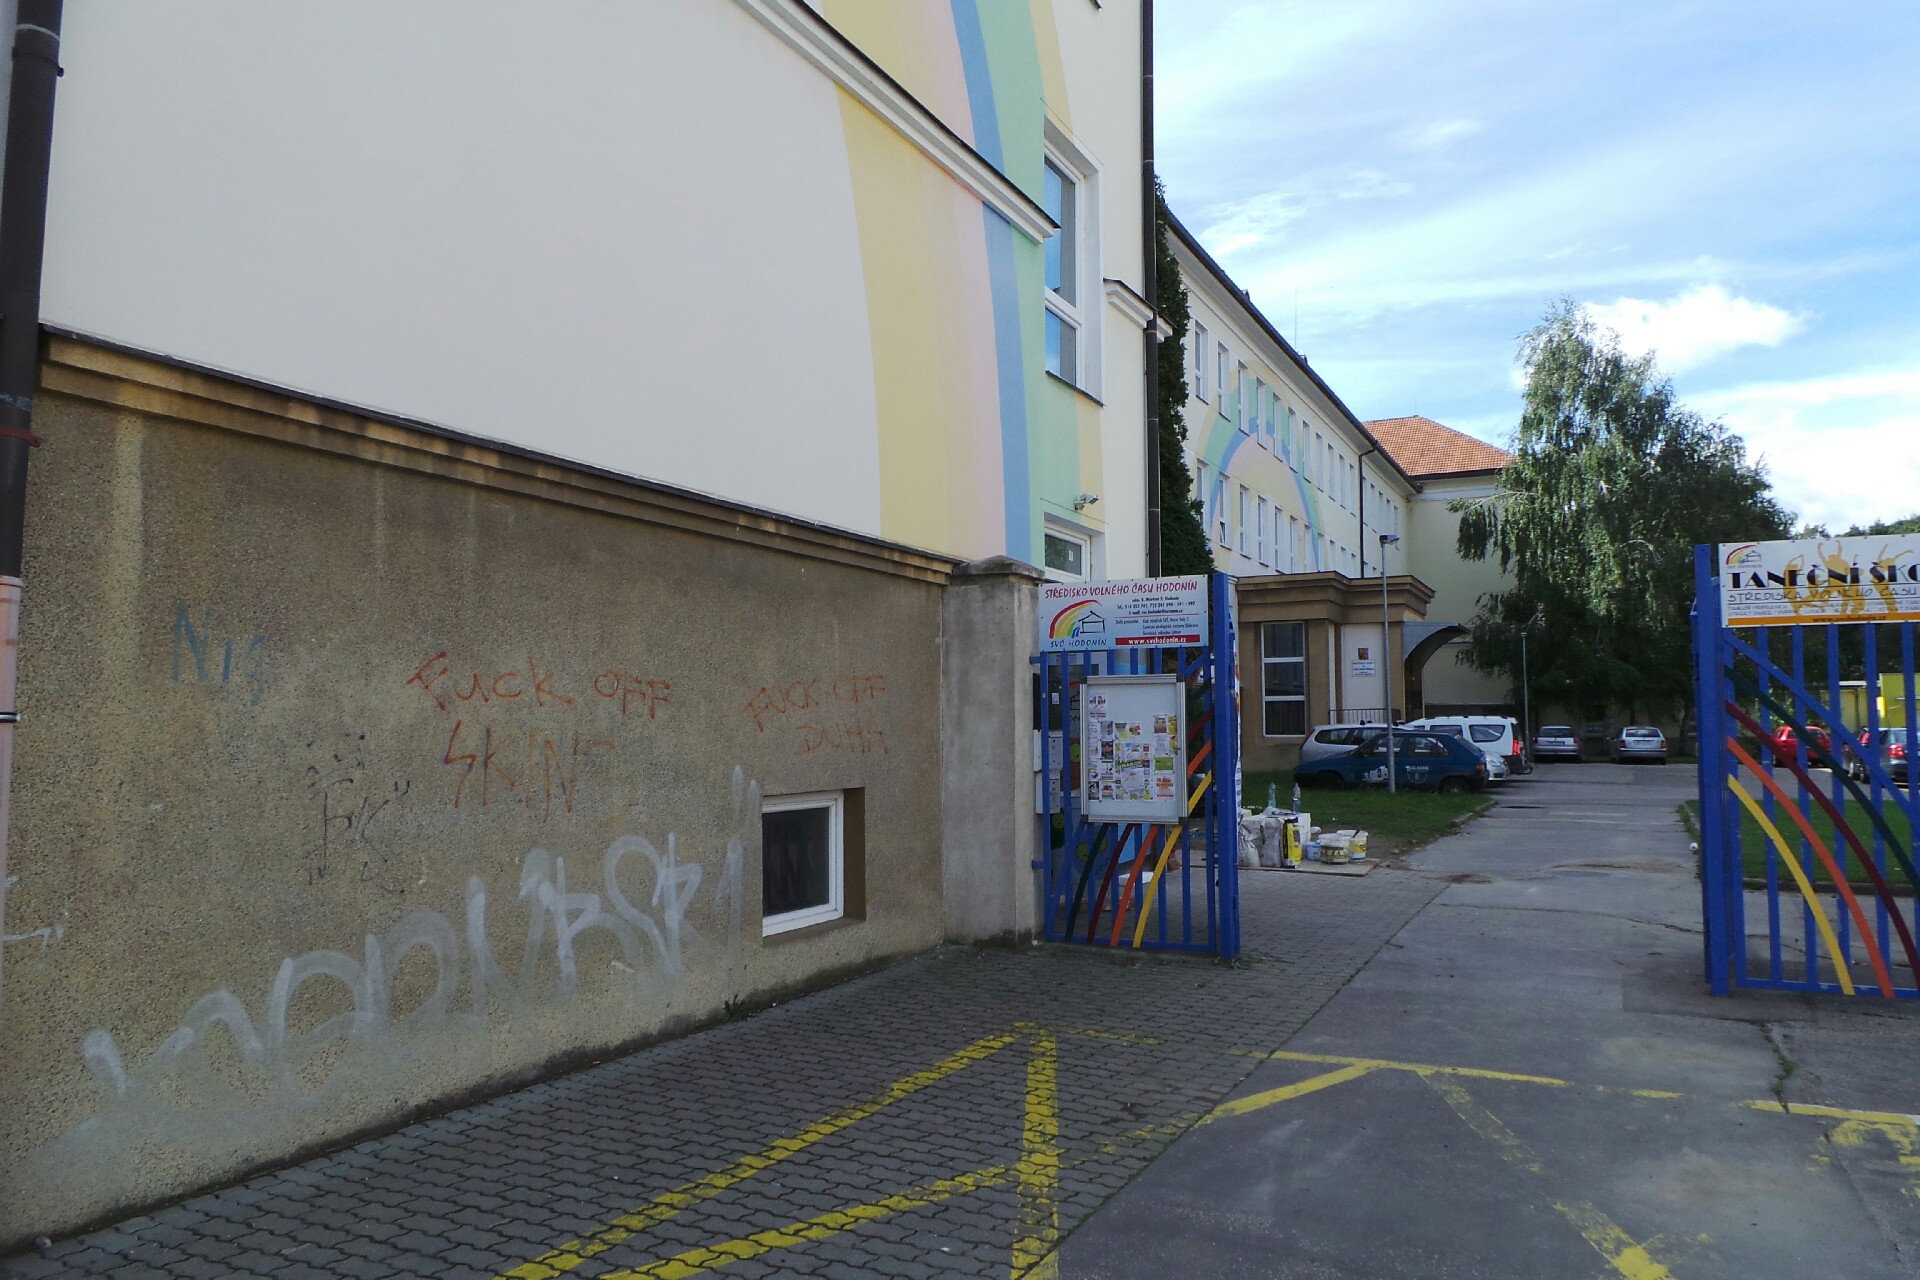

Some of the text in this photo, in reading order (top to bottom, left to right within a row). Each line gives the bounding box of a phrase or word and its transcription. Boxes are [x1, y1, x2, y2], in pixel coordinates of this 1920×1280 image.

[1726, 562, 1861, 588] TANEČNÍ
[1045, 579, 1198, 599] STŘEDISKO VOLNÉHO ČASU HODONÍN
[1728, 591, 1801, 603] STŘEDISKA
[1068, 638, 1107, 647] HODONÍN
[594, 671, 672, 720] OFF
